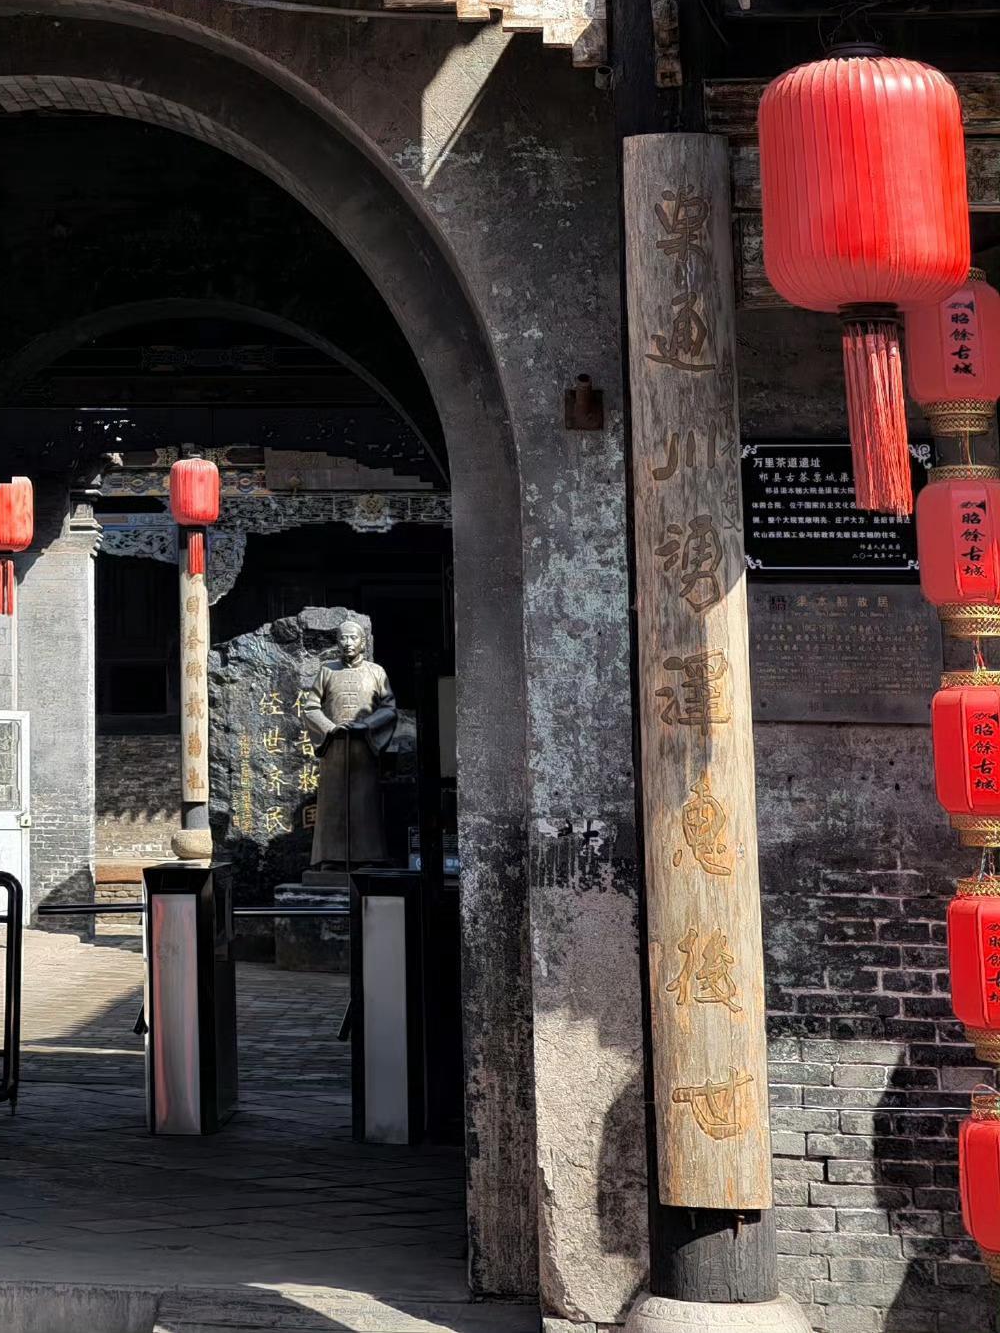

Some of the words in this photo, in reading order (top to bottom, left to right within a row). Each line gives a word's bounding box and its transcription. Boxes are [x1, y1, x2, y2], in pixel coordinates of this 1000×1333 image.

[753, 457, 821, 468] 万里茶道遗址
